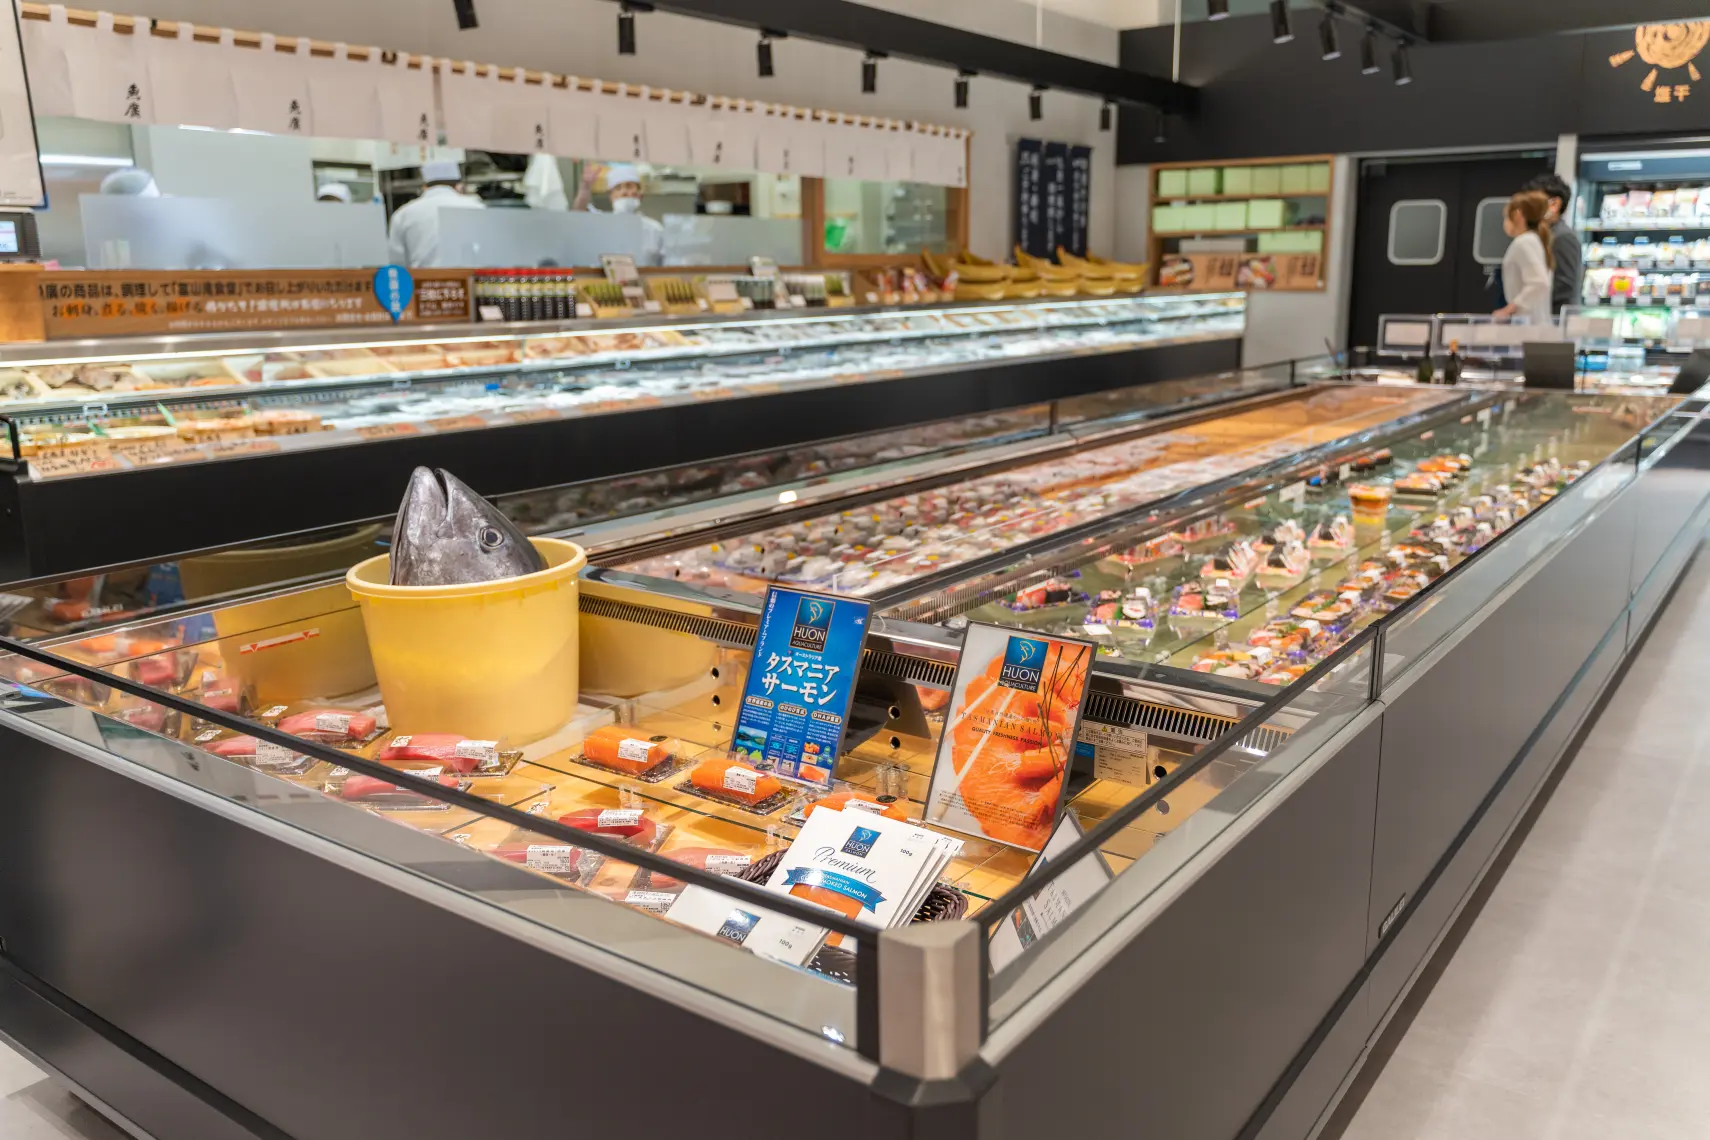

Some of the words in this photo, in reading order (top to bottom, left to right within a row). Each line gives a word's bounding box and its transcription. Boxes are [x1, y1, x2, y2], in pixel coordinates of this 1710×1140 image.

[794, 626, 826, 642] HUON
[792, 640, 822, 651] AQUACULTURE
[765, 652, 840, 684] タスマニア
[1002, 665, 1040, 683] HUON
[762, 672, 837, 706] サーモン
[961, 711, 1016, 731] TASMANIAN
[1020, 723, 1061, 741] SALMON
[845, 840, 870, 853] HUON
[900, 848, 913, 857] 100g
[813, 846, 877, 884] Premium
[842, 885, 867, 899] SALMON
[719, 926, 747, 943] HUON
[779, 938, 793, 950] 100g
